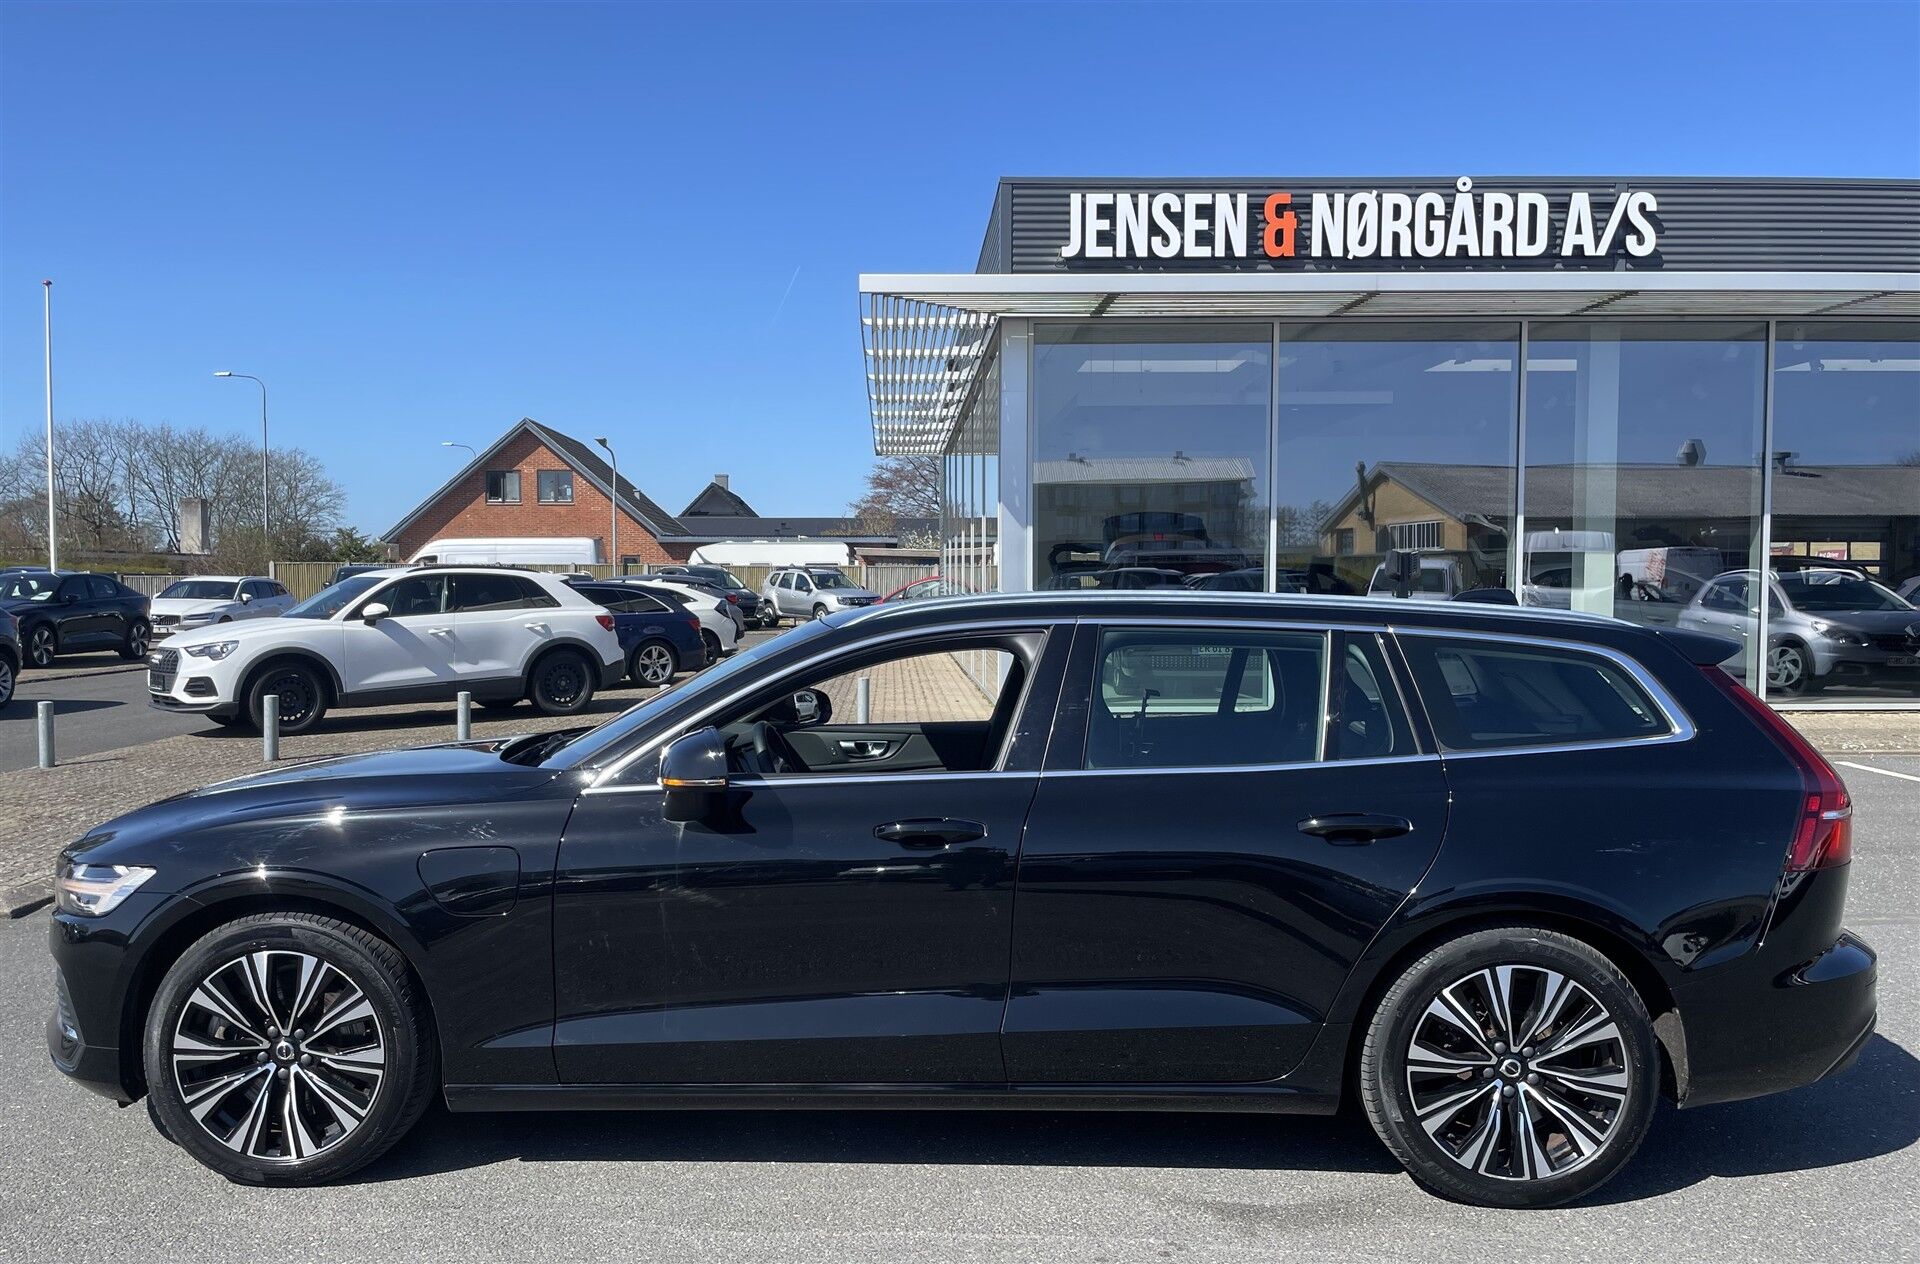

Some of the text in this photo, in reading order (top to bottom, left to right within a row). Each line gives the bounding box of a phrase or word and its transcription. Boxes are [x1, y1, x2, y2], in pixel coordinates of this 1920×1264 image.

[1060, 176, 1658, 259] JENSEN & NØRGÅRD A/S
